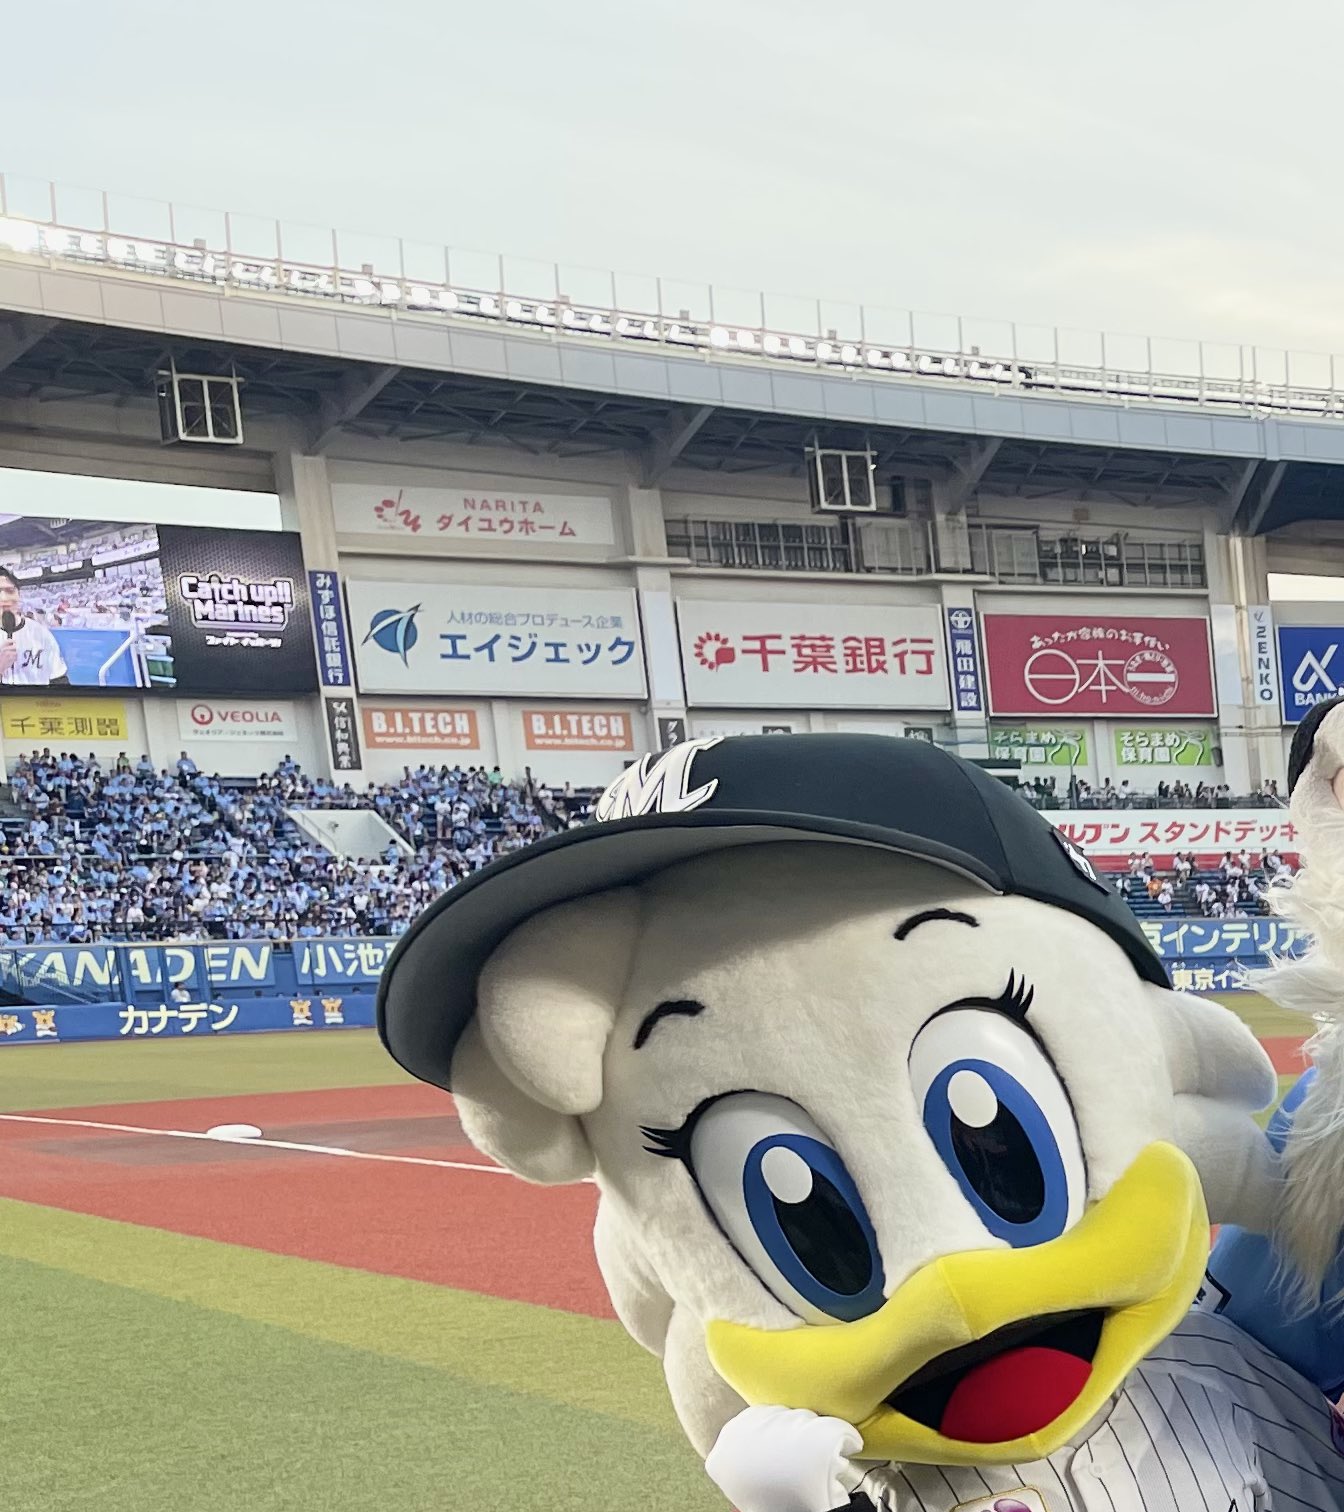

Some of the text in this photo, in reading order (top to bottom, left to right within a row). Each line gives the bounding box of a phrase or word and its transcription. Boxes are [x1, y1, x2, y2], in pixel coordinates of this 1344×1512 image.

[464, 498, 545, 514] NARITA
[436, 514, 577, 537] ダイユウホーム
[181, 574, 247, 604] Catch
[194, 599, 285, 623] Marines
[446, 611, 624, 630] 人材の総合プロデュース企業
[439, 632, 635, 666] エイジェック
[741, 633, 936, 676] 千葉銀行
[1256, 625, 1273, 701] ZENKO
[10, 716, 121, 737] 千葉測器
[217, 710, 283, 723] VEOLIA
[371, 711, 470, 735] B.I.TECH
[531, 711, 625, 736] B.I.TECH
[993, 731, 1057, 746] そらまめ
[1119, 730, 1182, 747] そらまめ
[1120, 747, 1172, 764] 保育園
[1138, 819, 1299, 844] スタンドデッキ
[300, 942, 390, 978] 小池
[119, 1001, 239, 1036] カナデン
